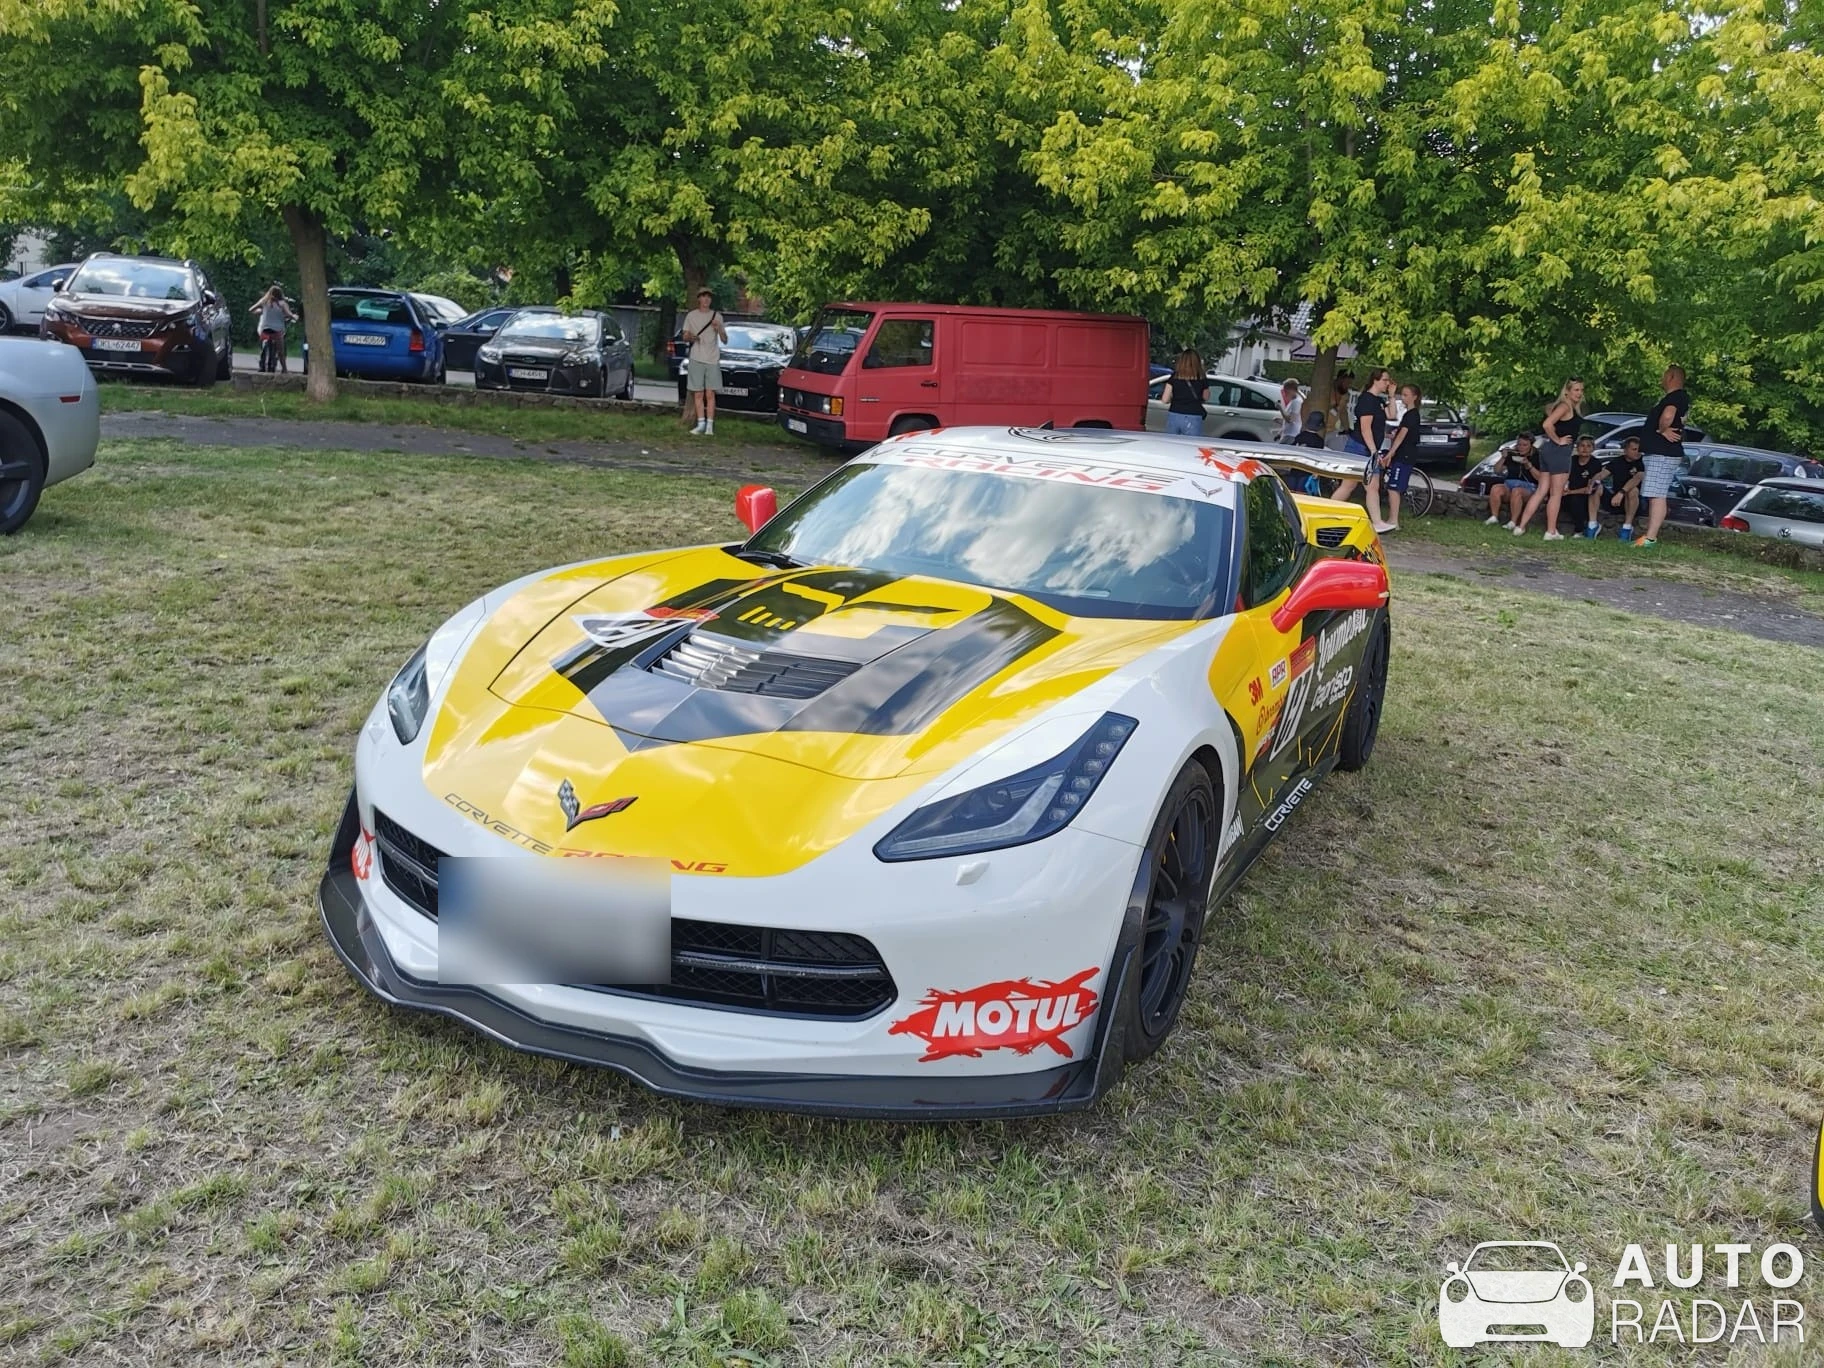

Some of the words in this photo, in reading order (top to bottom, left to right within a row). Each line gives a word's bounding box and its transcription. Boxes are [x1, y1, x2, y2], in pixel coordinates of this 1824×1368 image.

[899, 455, 1171, 491] RACING
[903, 447, 1185, 483] CORVETTE
[1248, 675, 1263, 706] 3M
[444, 792, 553, 855] CORVETTE
[1264, 777, 1313, 832] CORVETTE
[931, 993, 1082, 1038] MOTUL
